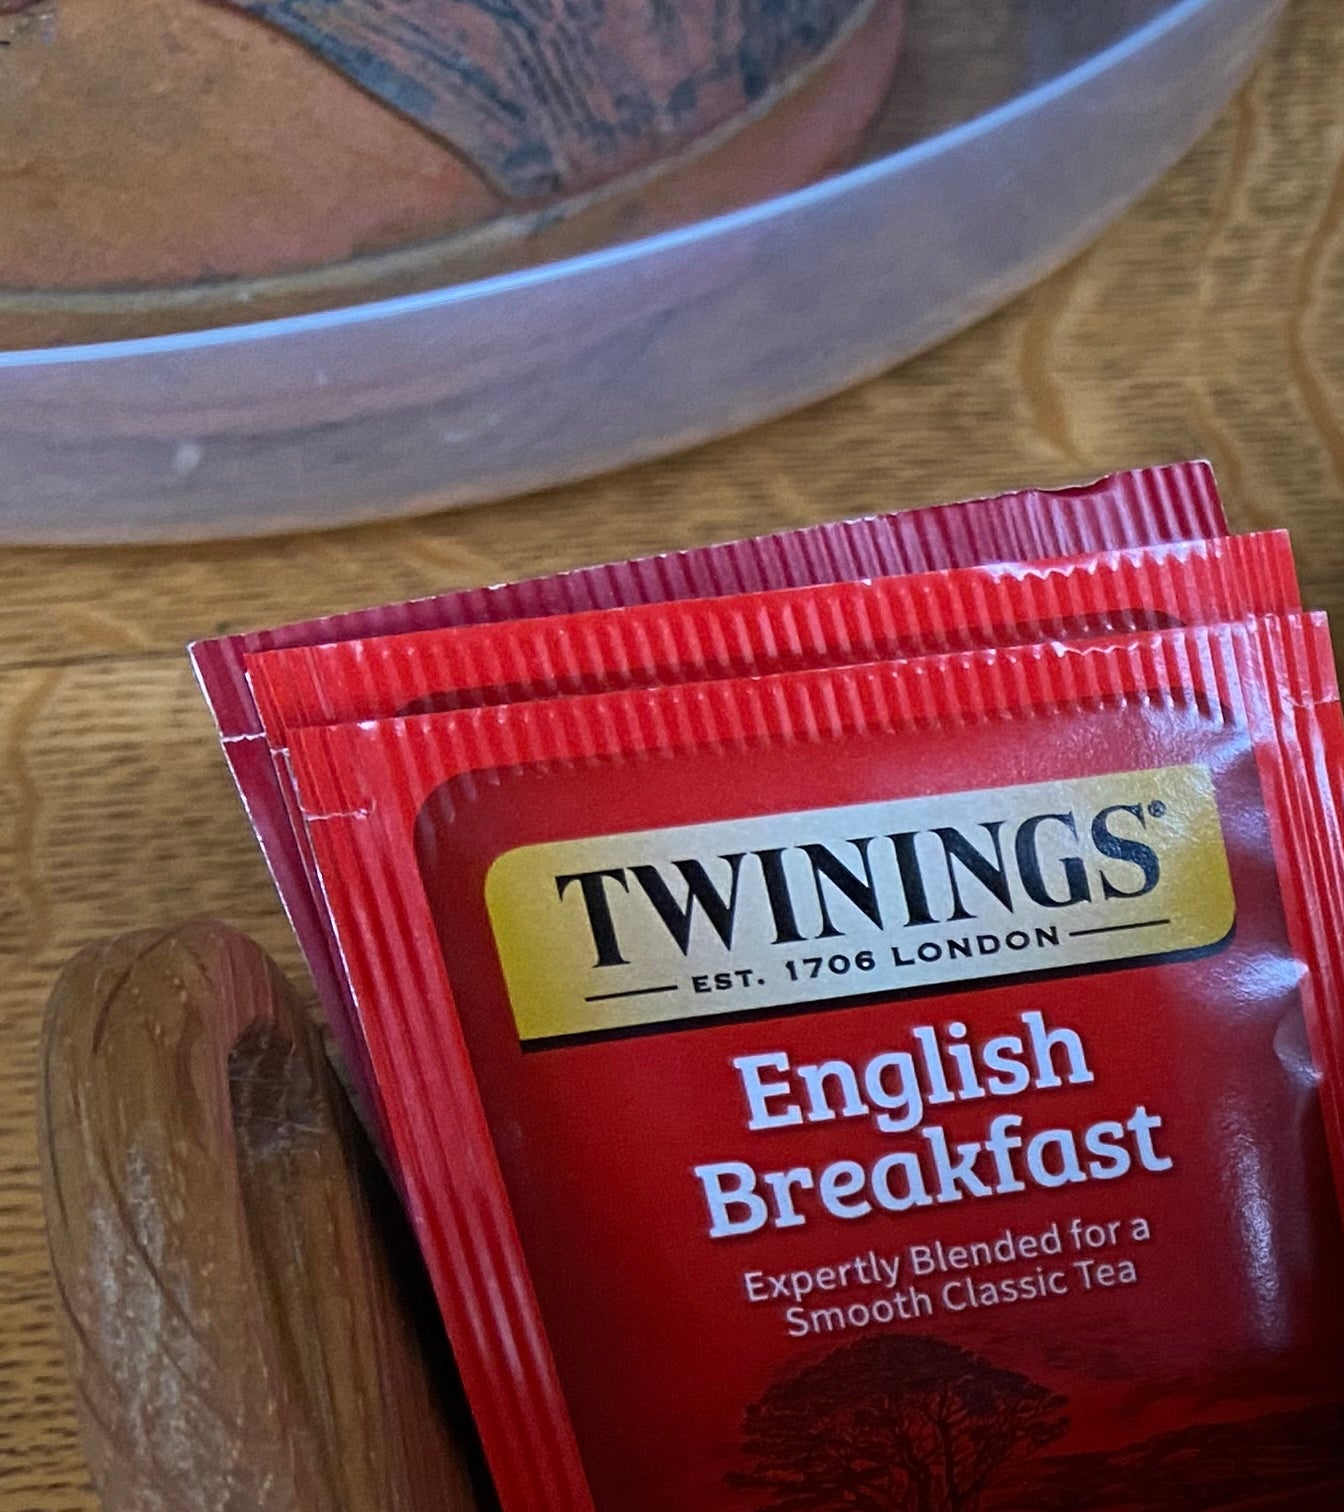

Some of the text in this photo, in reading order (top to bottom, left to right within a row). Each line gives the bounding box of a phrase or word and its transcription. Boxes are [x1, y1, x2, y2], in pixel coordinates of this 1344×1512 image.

[691, 925, 1062, 996] EST. 1706 LONDON
[733, 1011, 1094, 1132] English
[694, 1105, 1173, 1239] Breakfast
[744, 1217, 1151, 1304] Expertly Blended for a
[786, 1257, 1137, 1338] Smooth Classic Tea
